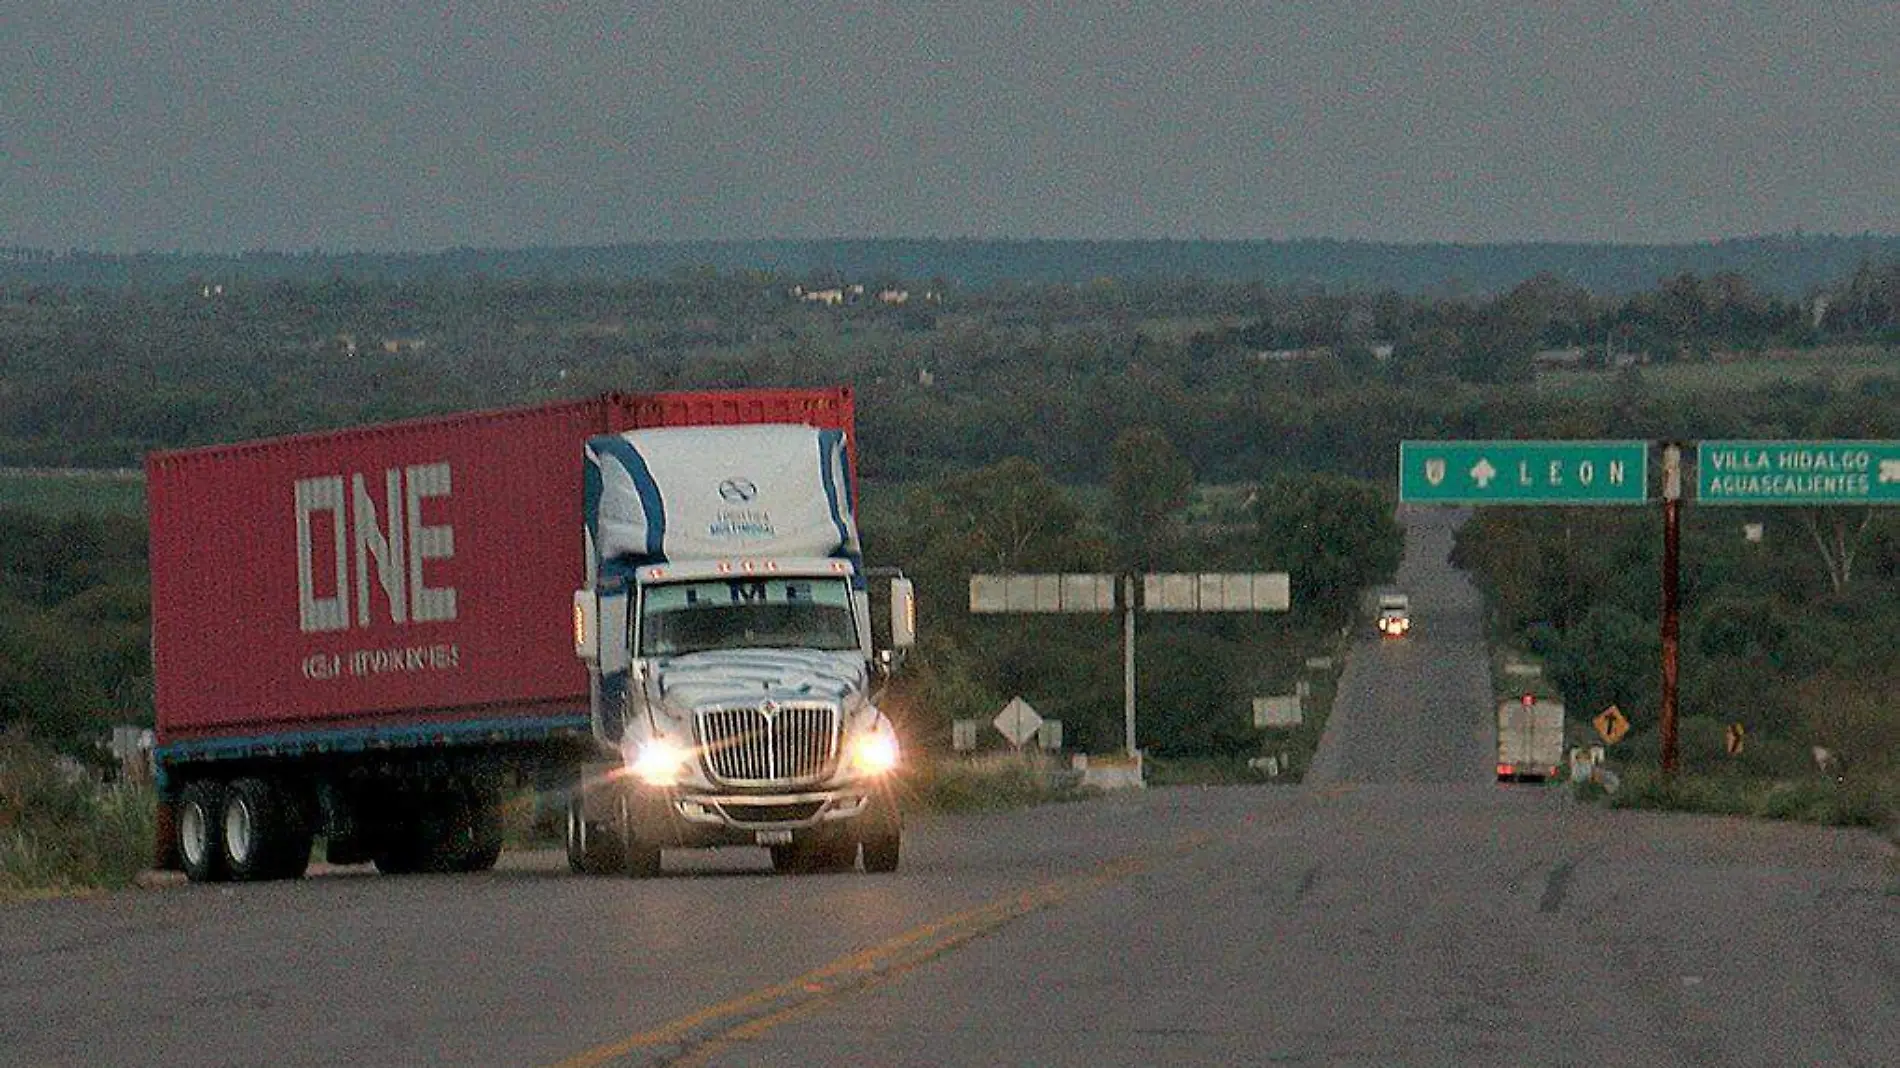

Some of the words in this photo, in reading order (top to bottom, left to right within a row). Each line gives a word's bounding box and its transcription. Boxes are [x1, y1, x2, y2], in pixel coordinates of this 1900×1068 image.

[1518, 459, 1624, 486] LEON
[1712, 450, 1770, 470] VILLA
[1779, 450, 1869, 471] HIDALGO
[1711, 473, 1869, 495] AGUASCALIENTES
[294, 462, 457, 632] ONE
